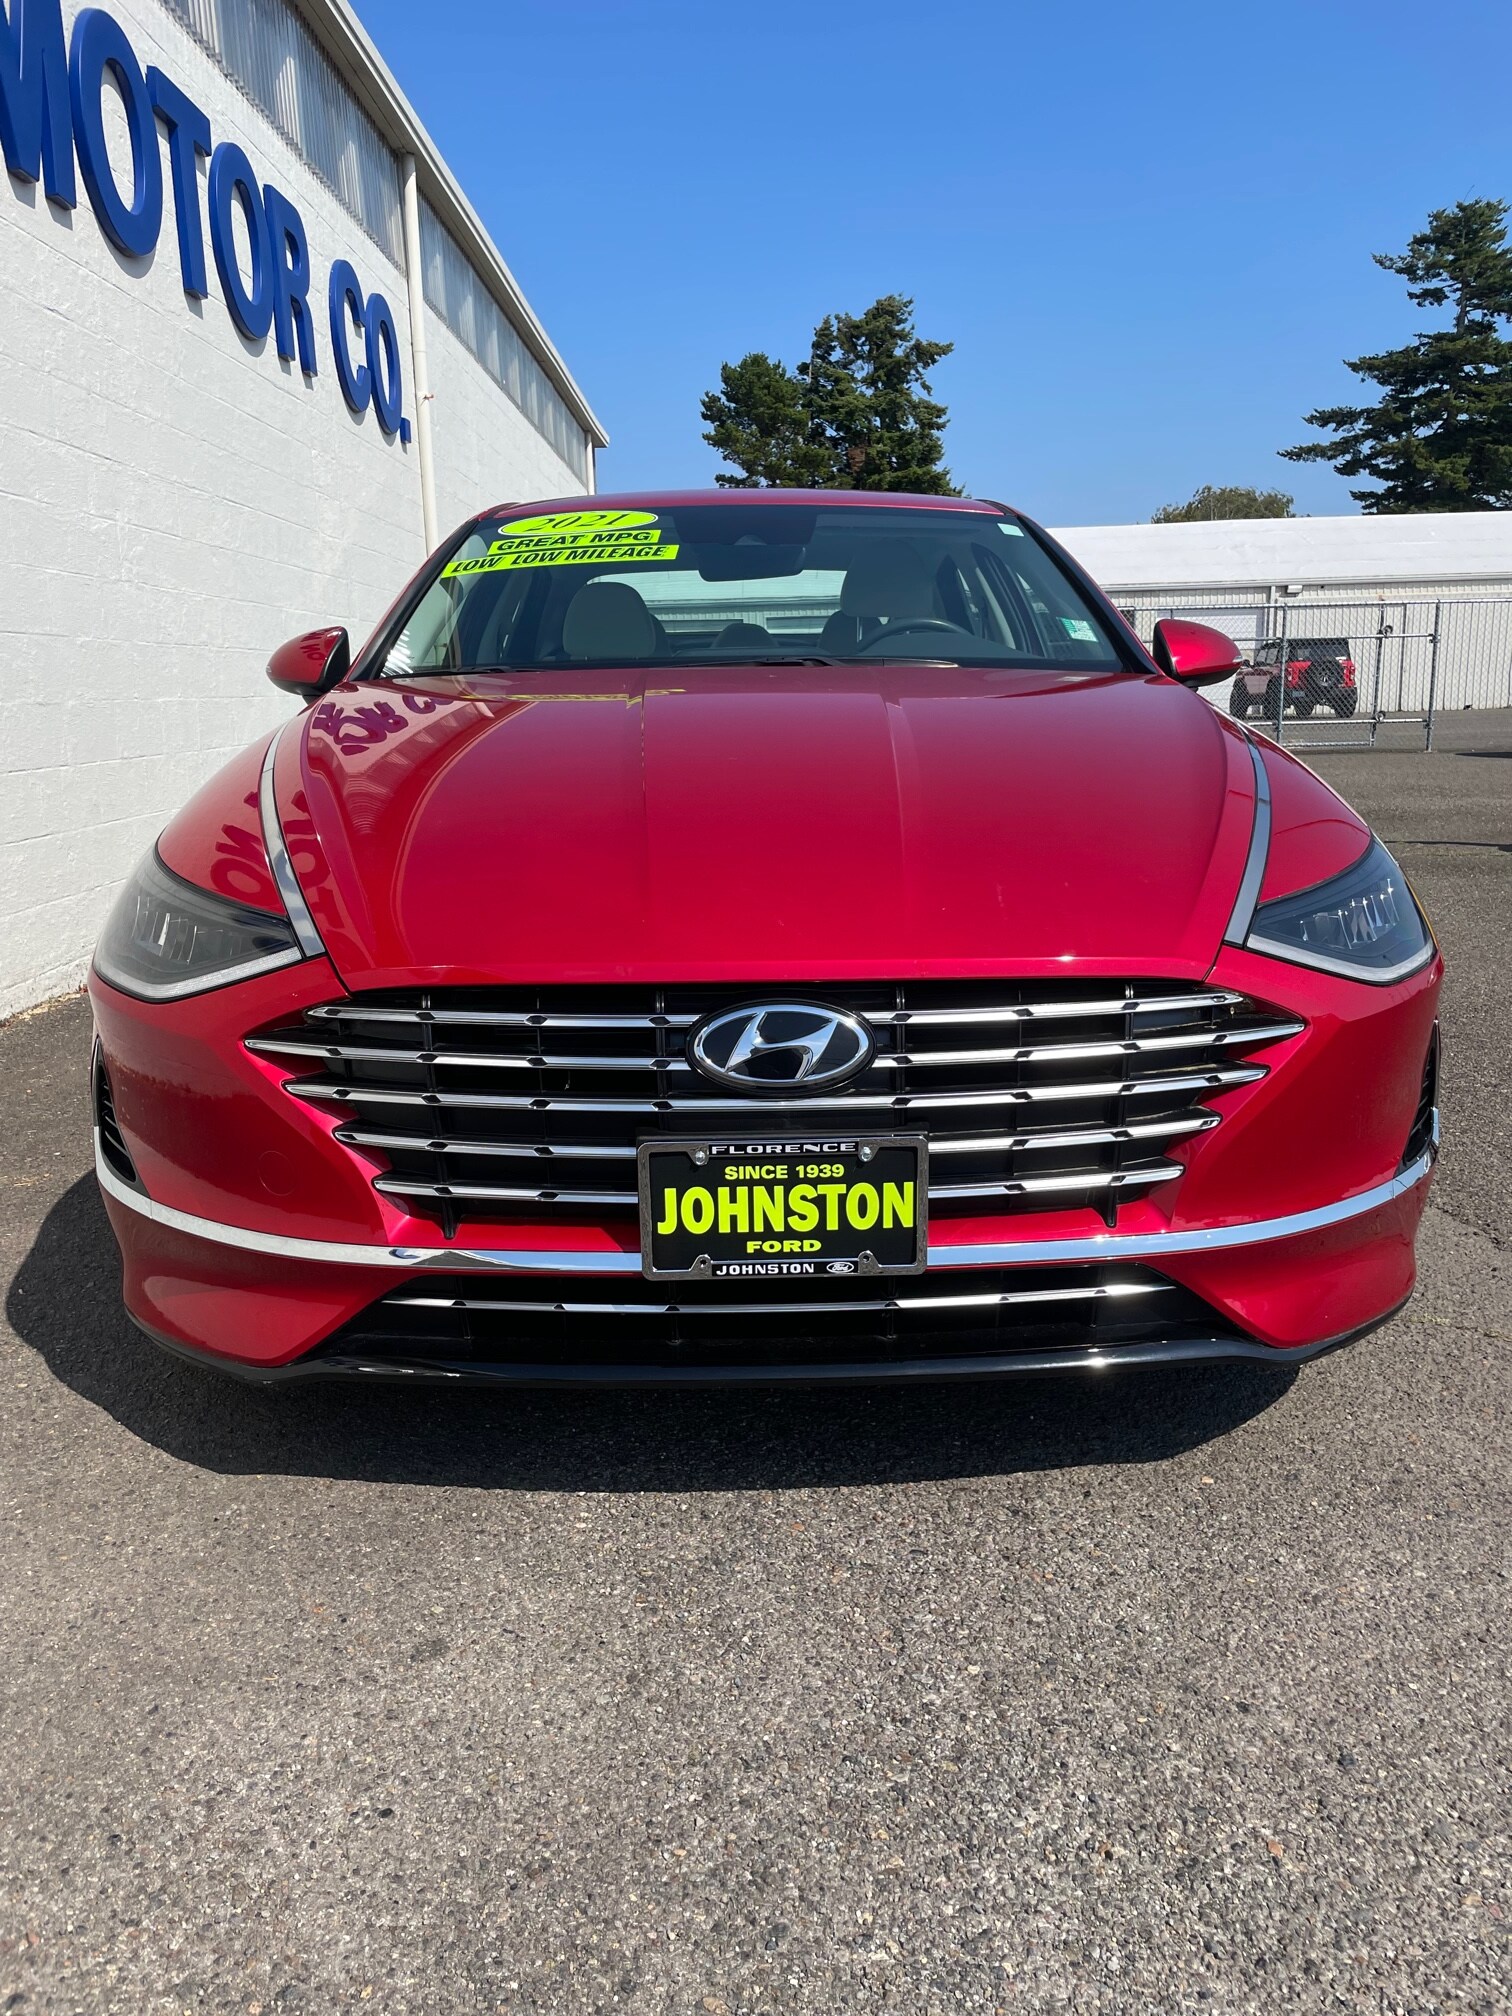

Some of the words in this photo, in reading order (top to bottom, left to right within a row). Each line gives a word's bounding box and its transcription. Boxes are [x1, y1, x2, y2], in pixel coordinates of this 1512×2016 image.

[0, 0, 318, 378] MOTOR
[329, 259, 412, 444] CO.
[528, 513, 631, 532] 2021
[496, 534, 587, 551] GREAT
[590, 530, 653, 543] MPG
[450, 556, 503, 573] LOW
[512, 551, 563, 566] LOW
[563, 545, 668, 561] MILEAGE
[711, 1142, 857, 1155] FLORENCE
[724, 1164, 788, 1180] SINCE
[795, 1163, 845, 1178] 1939
[657, 1181, 915, 1235] JOHNSTON
[746, 1239, 822, 1254] FORD
[715, 1263, 815, 1276] JOHNSTON
